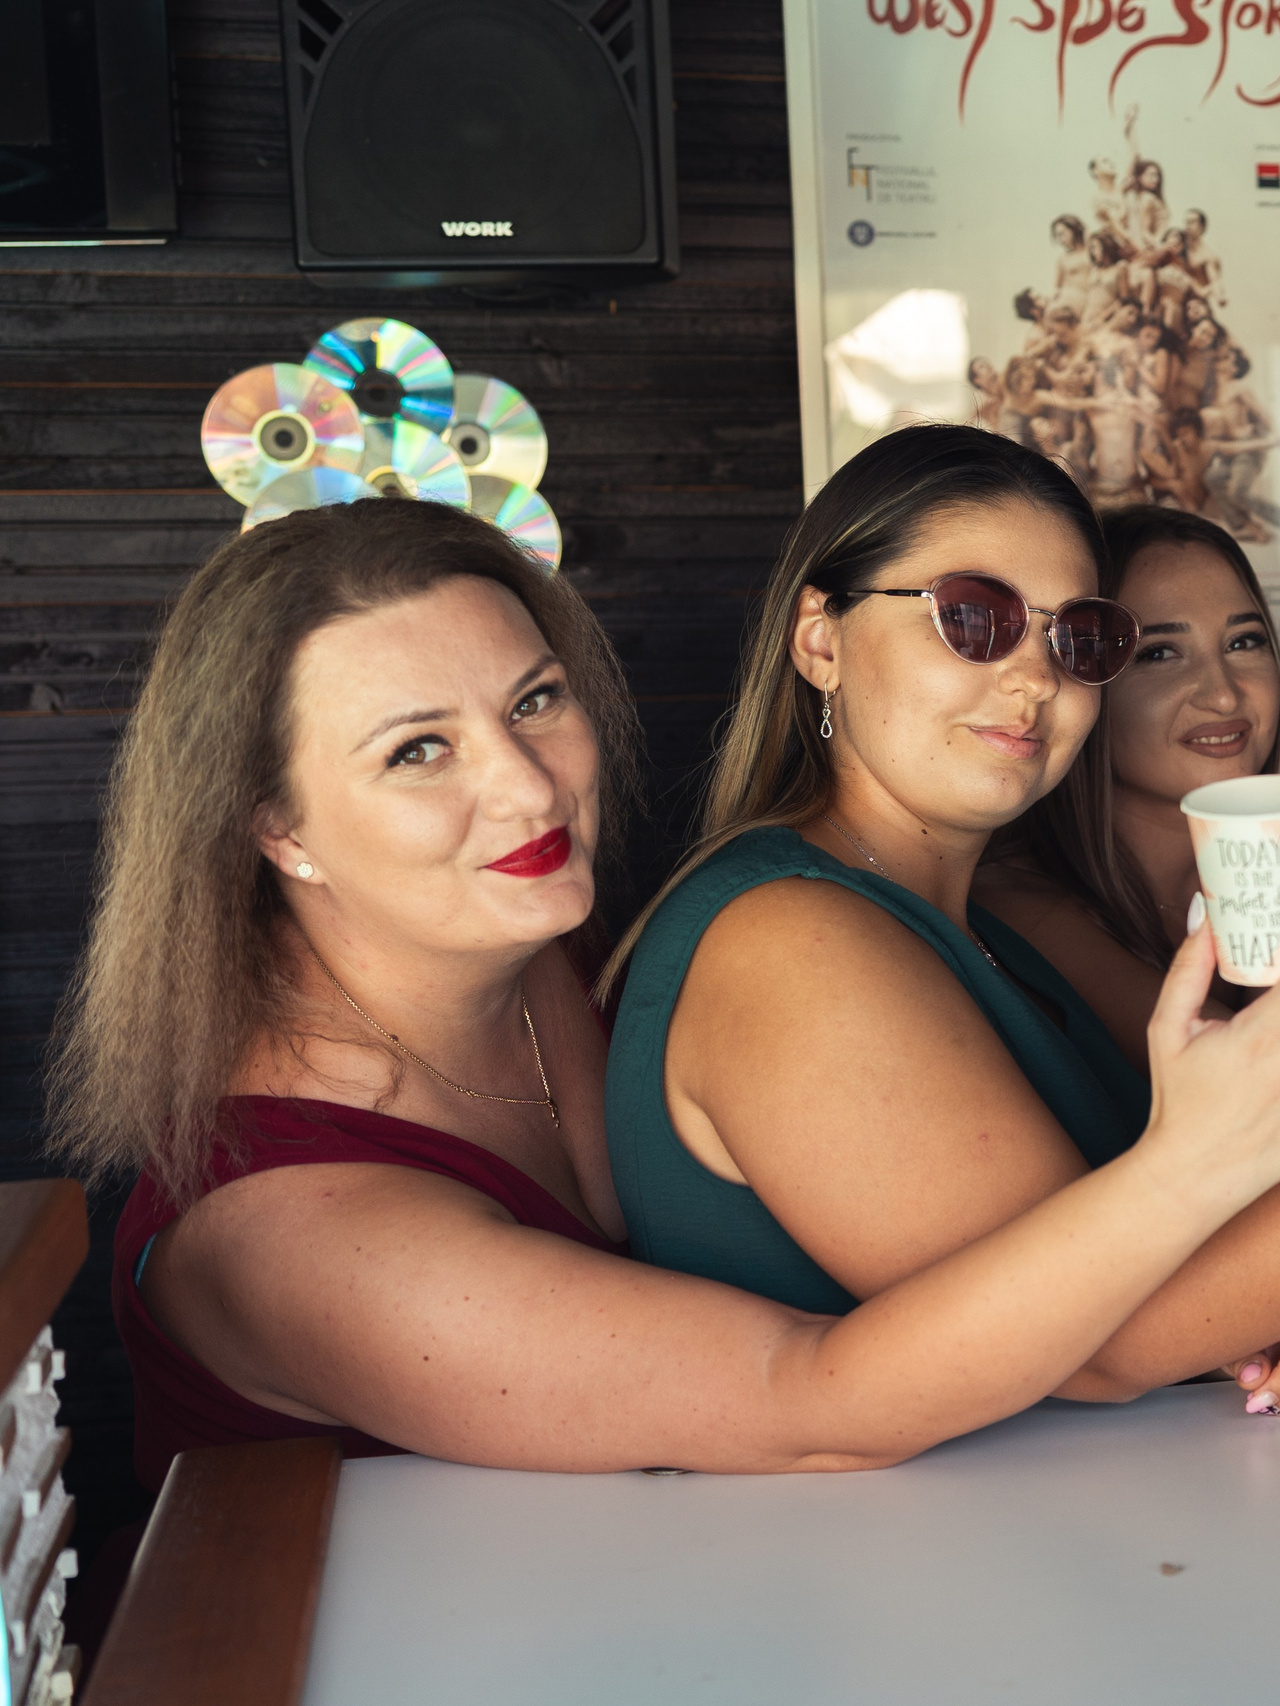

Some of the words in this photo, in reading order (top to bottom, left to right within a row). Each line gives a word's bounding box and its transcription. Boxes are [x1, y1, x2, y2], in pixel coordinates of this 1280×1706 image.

[441, 221, 515, 237] WORK
[1234, 871, 1248, 888] IS
[1252, 871, 1273, 887] THE
[1219, 891, 1267, 916] perfect
[1253, 914, 1265, 928] TO
